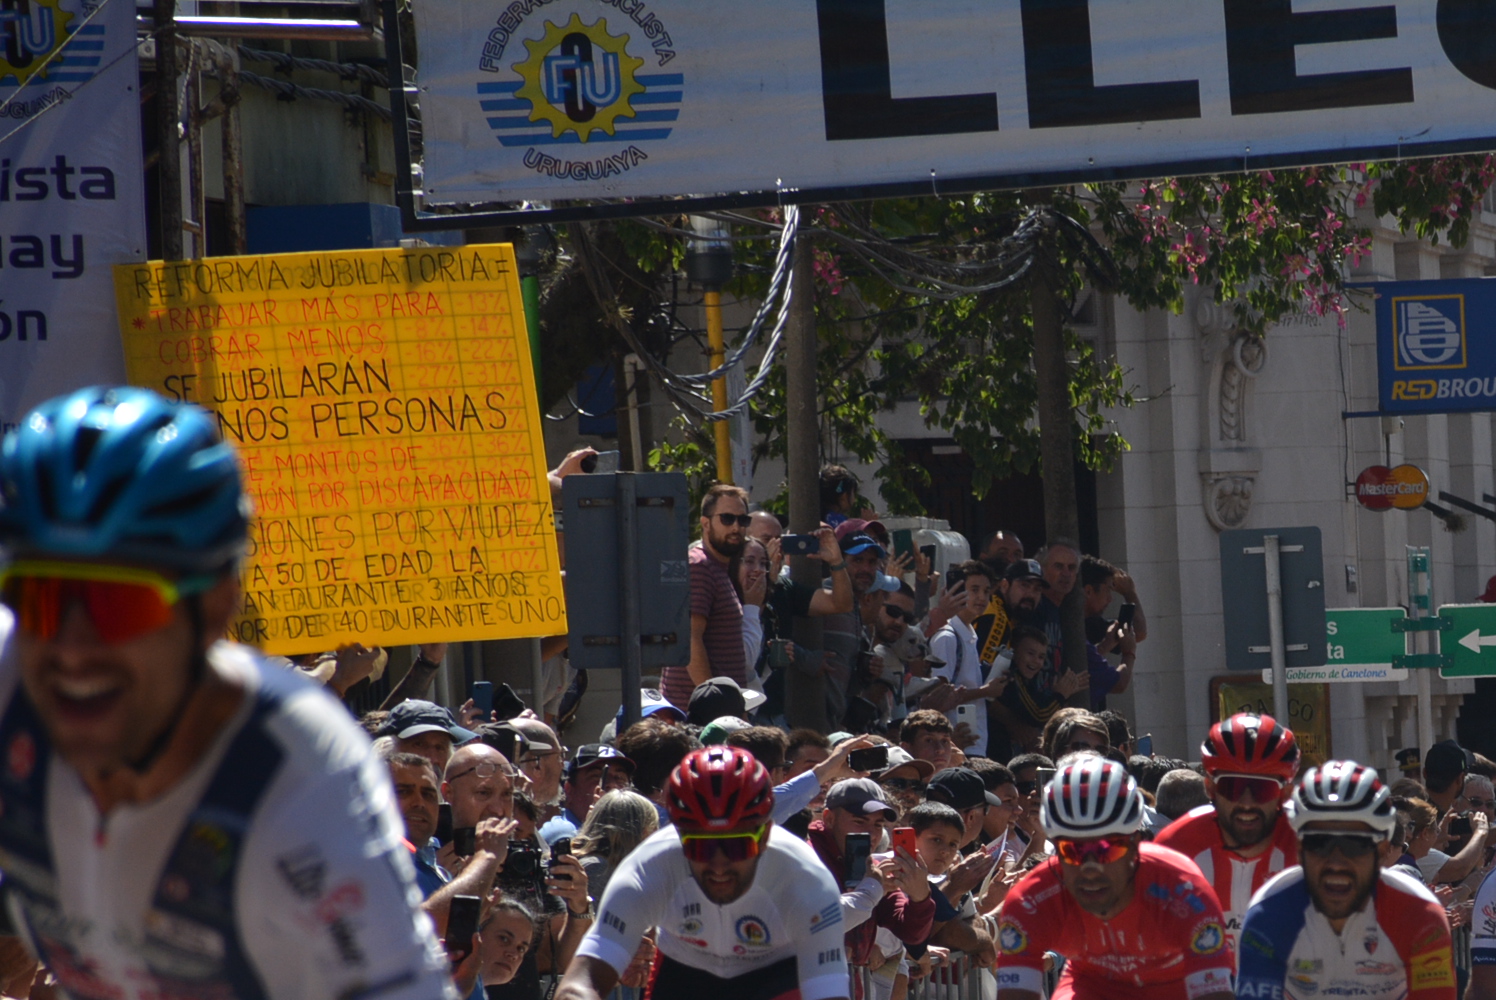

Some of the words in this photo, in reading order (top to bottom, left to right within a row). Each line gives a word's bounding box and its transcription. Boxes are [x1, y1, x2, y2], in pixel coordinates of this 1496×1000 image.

[523, 146, 648, 181] URUGUAYA
[133, 260, 289, 298] REFORMA
[150, 299, 281, 332] TRABAJAR
[301, 290, 359, 321] MÁS
[374, 290, 444, 318] PARA
[158, 333, 264, 366] COBRAR
[287, 323, 384, 358] MENOS
[164, 374, 200, 406] SE
[213, 354, 392, 404] JUBILARÁN
[203, 405, 290, 444] NOS
[310, 391, 508, 439] PERSONAS
[275, 449, 379, 479] MONTOS
[390, 445, 427, 472] DE
[308, 480, 349, 509] POR
[359, 468, 532, 506] DISCAPACIDAD
[1358, 480, 1424, 496] MasterCard
[372, 509, 437, 547] POR
[276, 562, 305, 586] 50
[314, 556, 350, 582] DE
[364, 549, 433, 579] EDAD
[449, 545, 487, 574] LA
[290, 579, 412, 611] DURANTE
[427, 577, 443, 601] 3
[454, 570, 527, 600] AÑOS
[285, 614, 325, 640] DE
[339, 609, 368, 634] 40
[379, 602, 497, 632] DURANTE
[1286, 668, 1326, 680] Gobierno
[1328, 668, 1340, 679] de
[1341, 667, 1387, 679] Canelones
